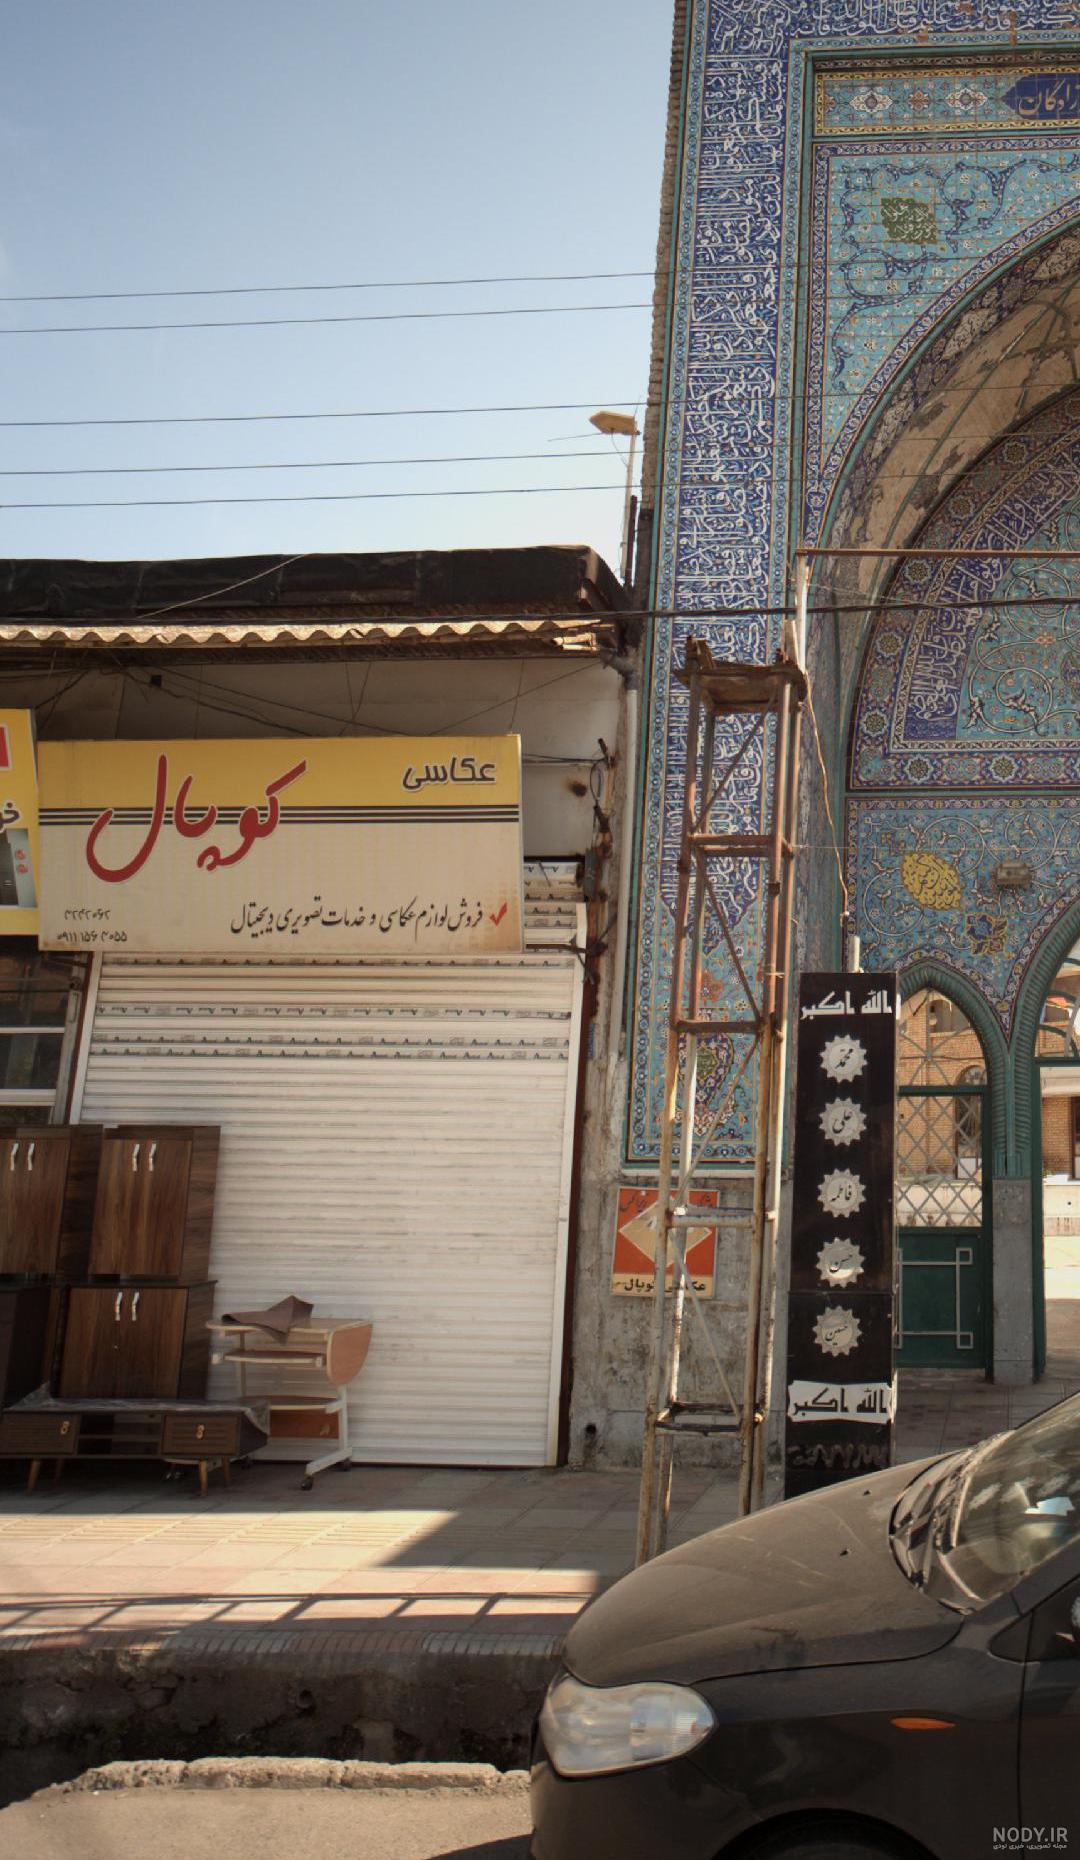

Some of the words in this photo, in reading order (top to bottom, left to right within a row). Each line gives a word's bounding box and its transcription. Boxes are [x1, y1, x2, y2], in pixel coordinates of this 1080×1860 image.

[402, 756, 496, 791] عکاسی
[86, 754, 307, 883] کوپال
[230, 901, 274, 938] دیجیتال
[276, 895, 323, 935] تصویری
[321, 906, 366, 928] خدمات
[369, 912, 377, 926] و
[379, 896, 418, 933] عکاسی
[414, 903, 448, 943] لوازم
[447, 897, 483, 932] فروش
[861, 989, 893, 1014] الله
[856, 1387, 887, 1413] الله
